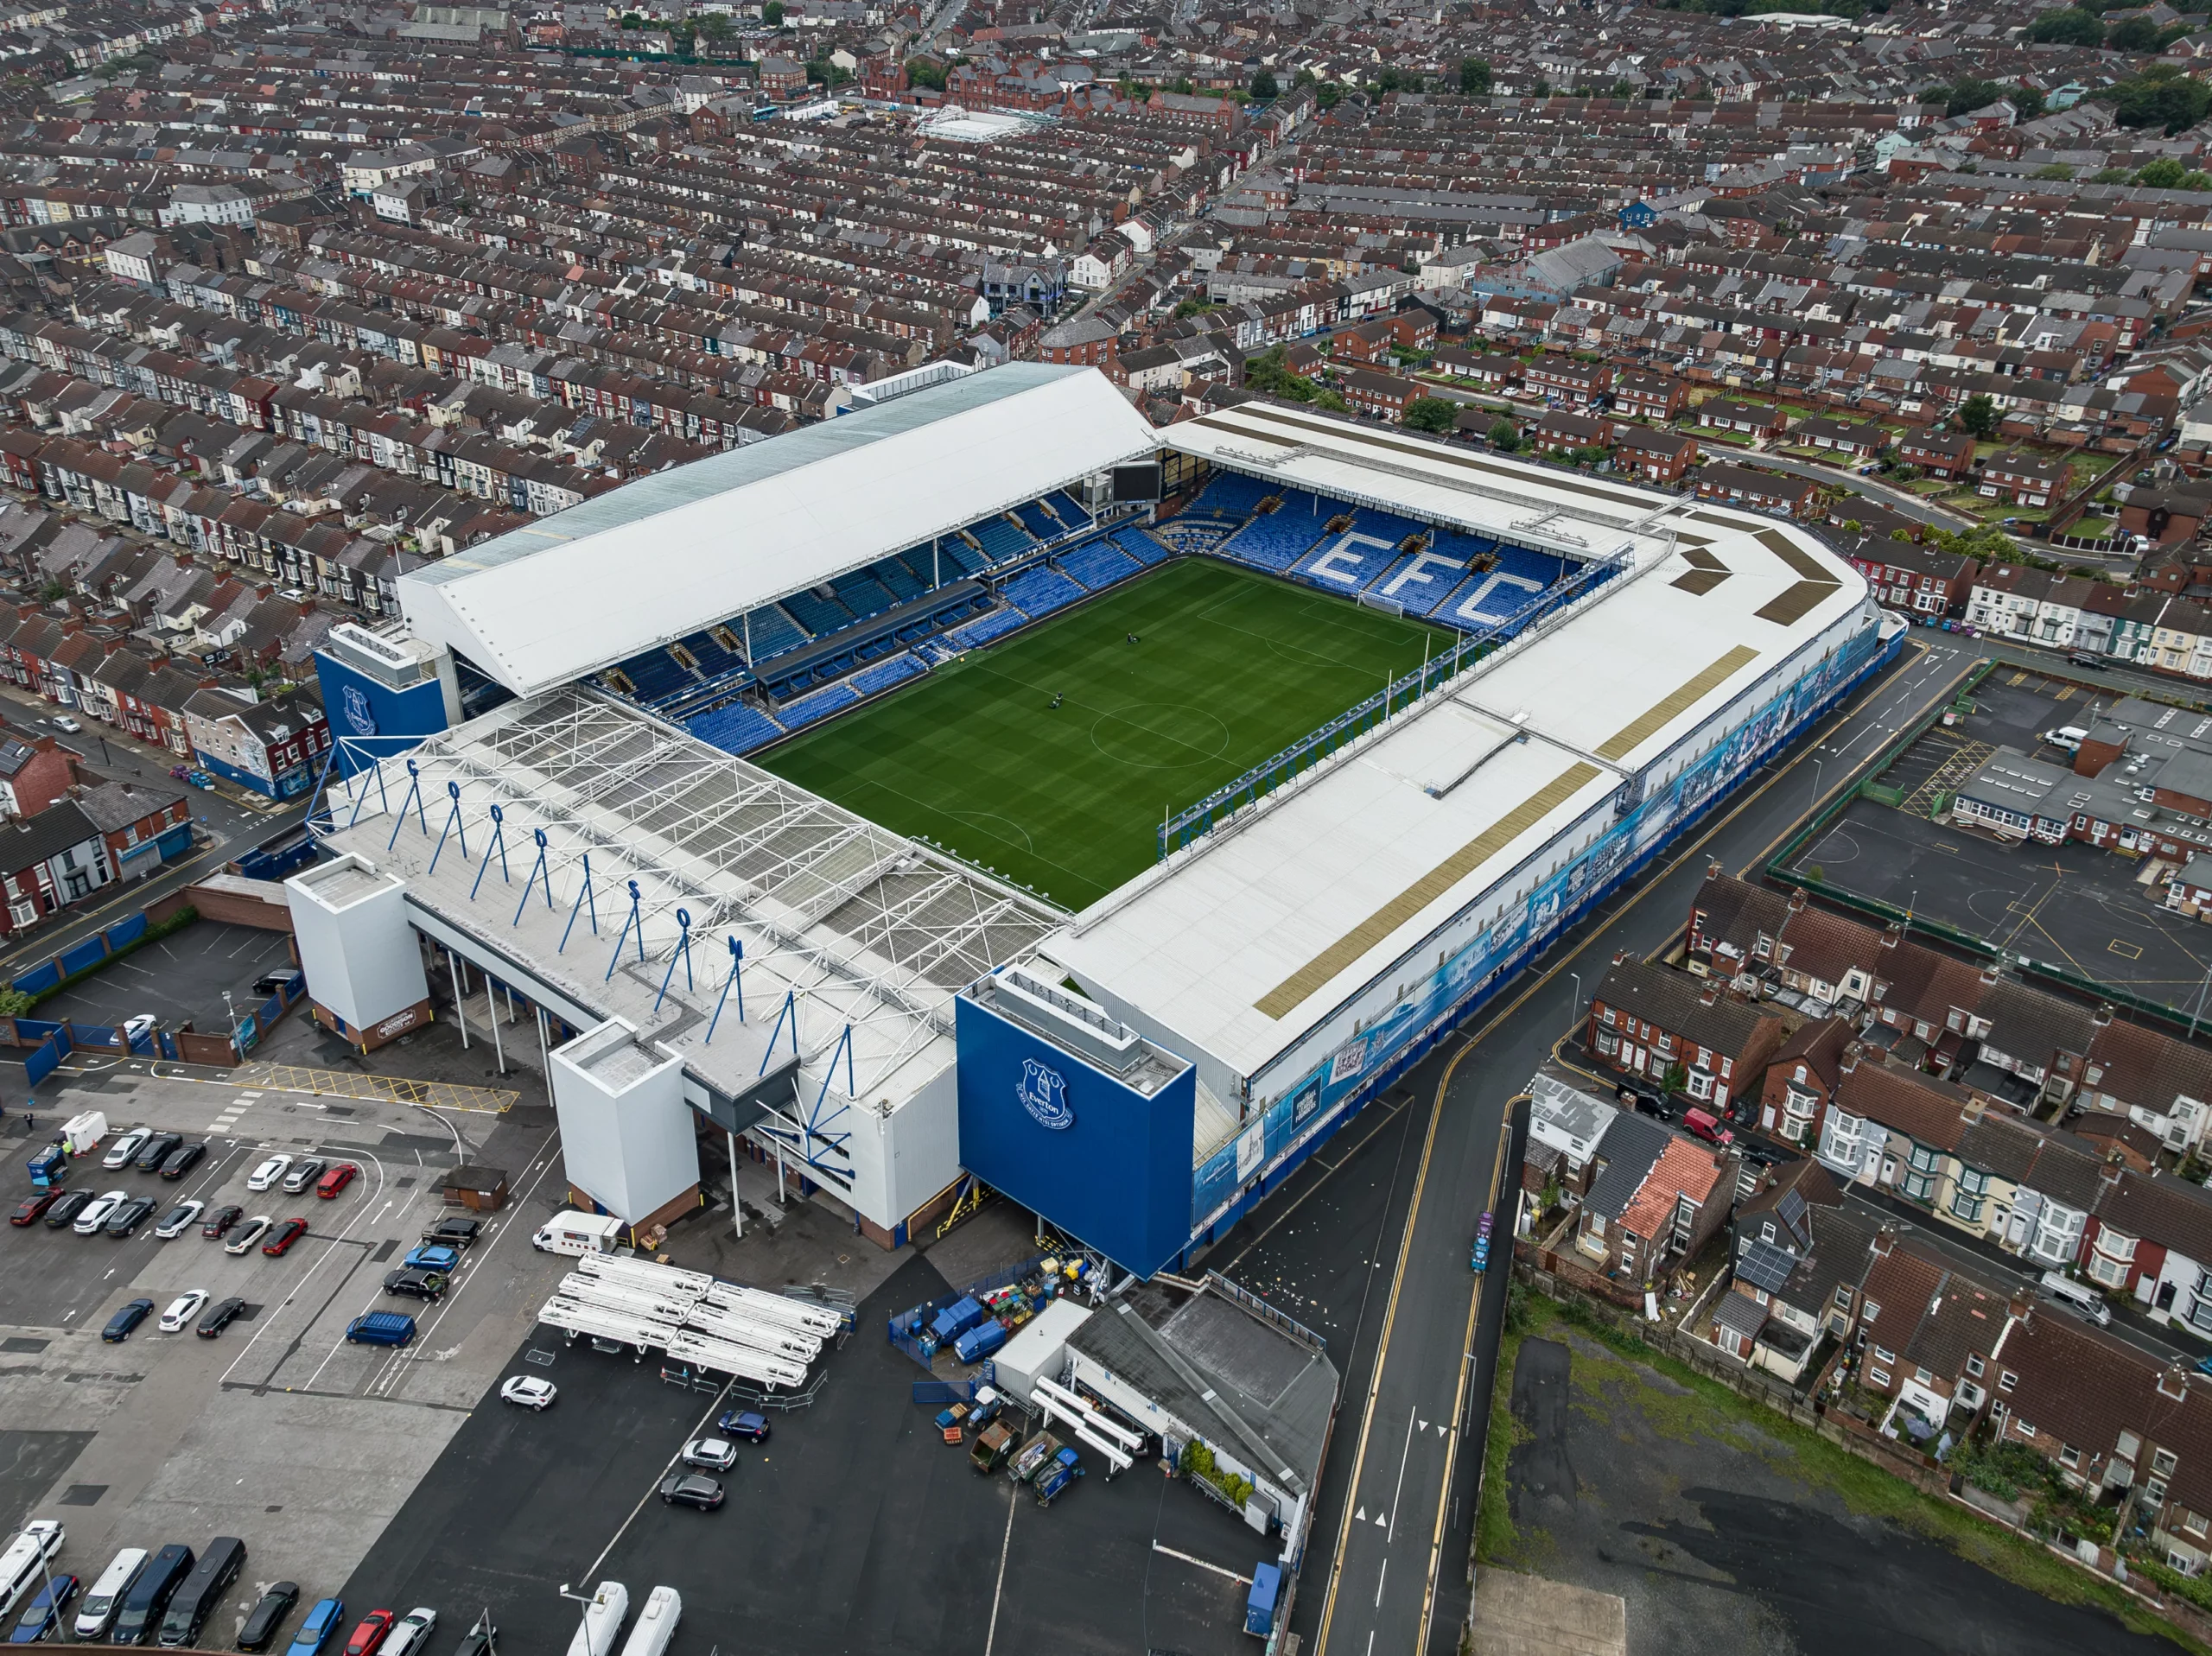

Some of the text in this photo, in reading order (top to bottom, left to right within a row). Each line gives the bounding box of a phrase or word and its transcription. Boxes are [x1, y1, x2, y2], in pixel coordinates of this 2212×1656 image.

[1334, 486, 1359, 498] HOWARD
[1361, 493, 1389, 506] KENDALL
[1391, 502, 1421, 514] GWLADYS
[1423, 510, 1447, 521] STREET
[1307, 531, 1545, 626] EFC
[379, 1012, 414, 1033] GOODISON
[1028, 1091, 1059, 1115] Everton
